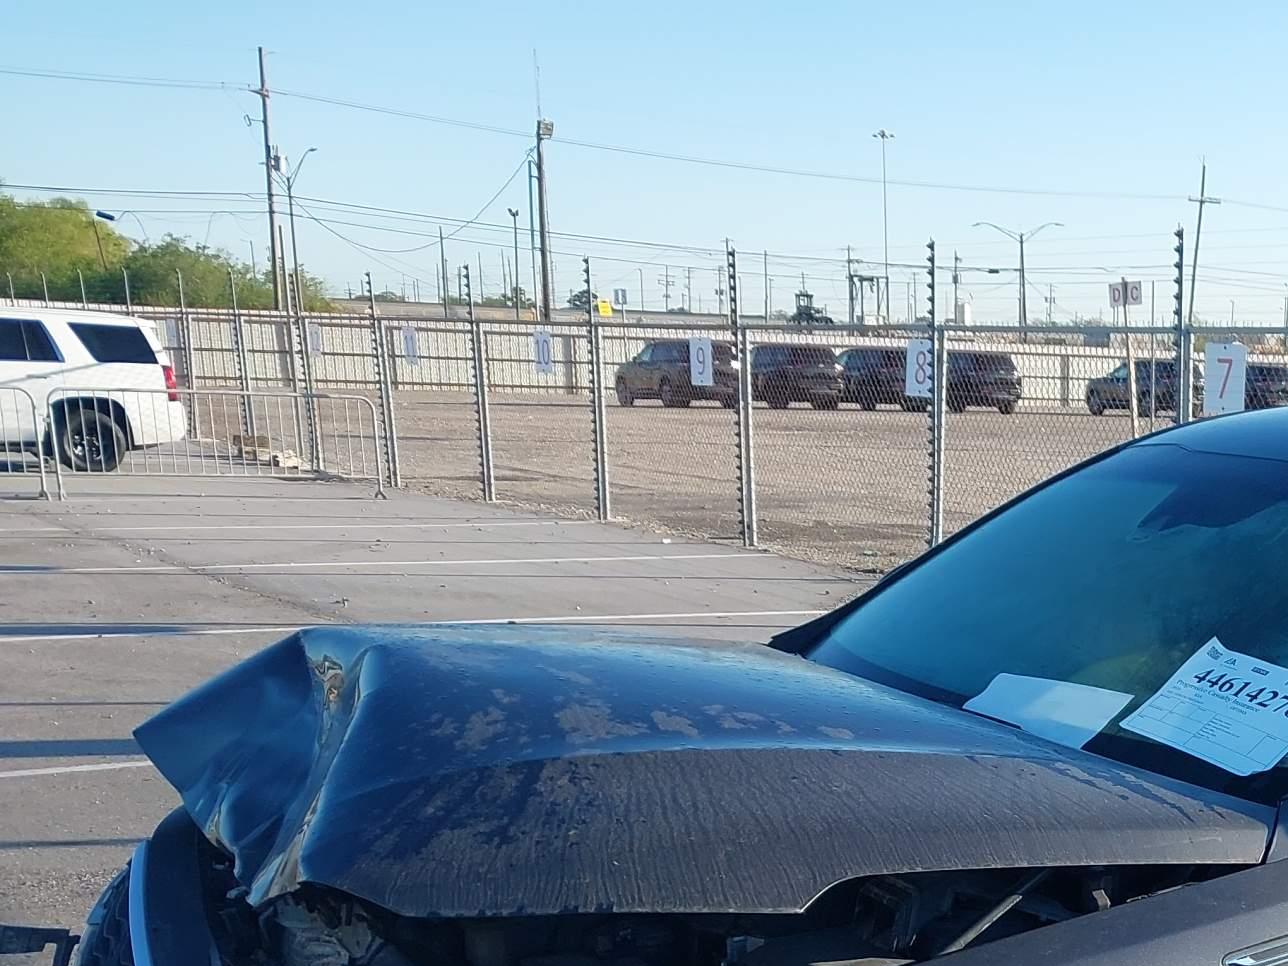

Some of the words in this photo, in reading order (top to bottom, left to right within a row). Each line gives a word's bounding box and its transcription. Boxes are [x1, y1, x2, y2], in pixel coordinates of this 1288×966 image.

[1112, 287, 1121, 303] D
[1129, 286, 1140, 302] C
[534, 339, 550, 365] 10
[696, 346, 706, 376] 9
[915, 350, 927, 385] 8
[1216, 357, 1233, 400] 7
